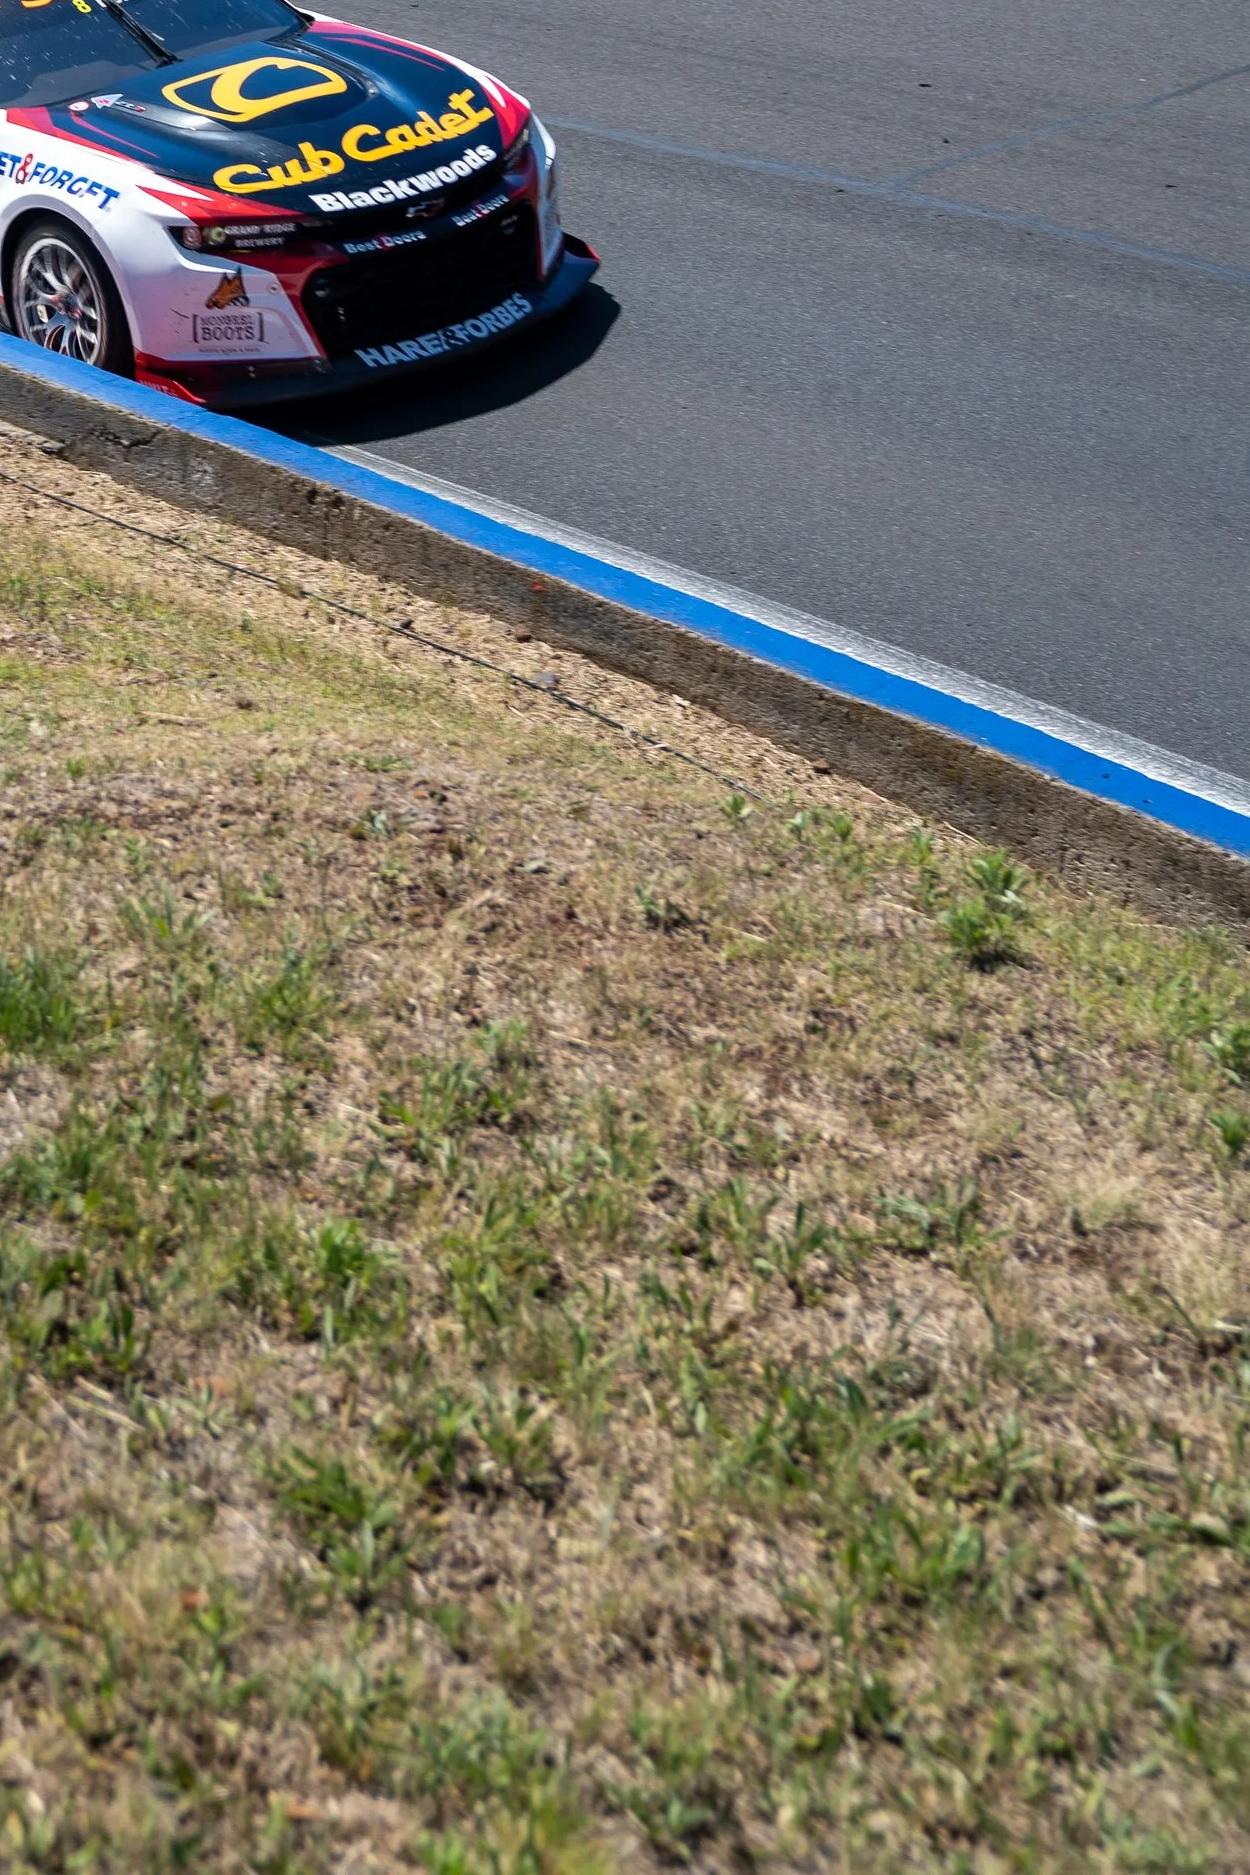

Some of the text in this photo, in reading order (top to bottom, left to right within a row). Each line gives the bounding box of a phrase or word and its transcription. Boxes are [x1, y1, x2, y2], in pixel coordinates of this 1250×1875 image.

[213, 141, 346, 194] Cub
[341, 89, 495, 162] Cadet
[309, 143, 498, 213] Blackwoods
[201, 325, 255, 341] BOOTS
